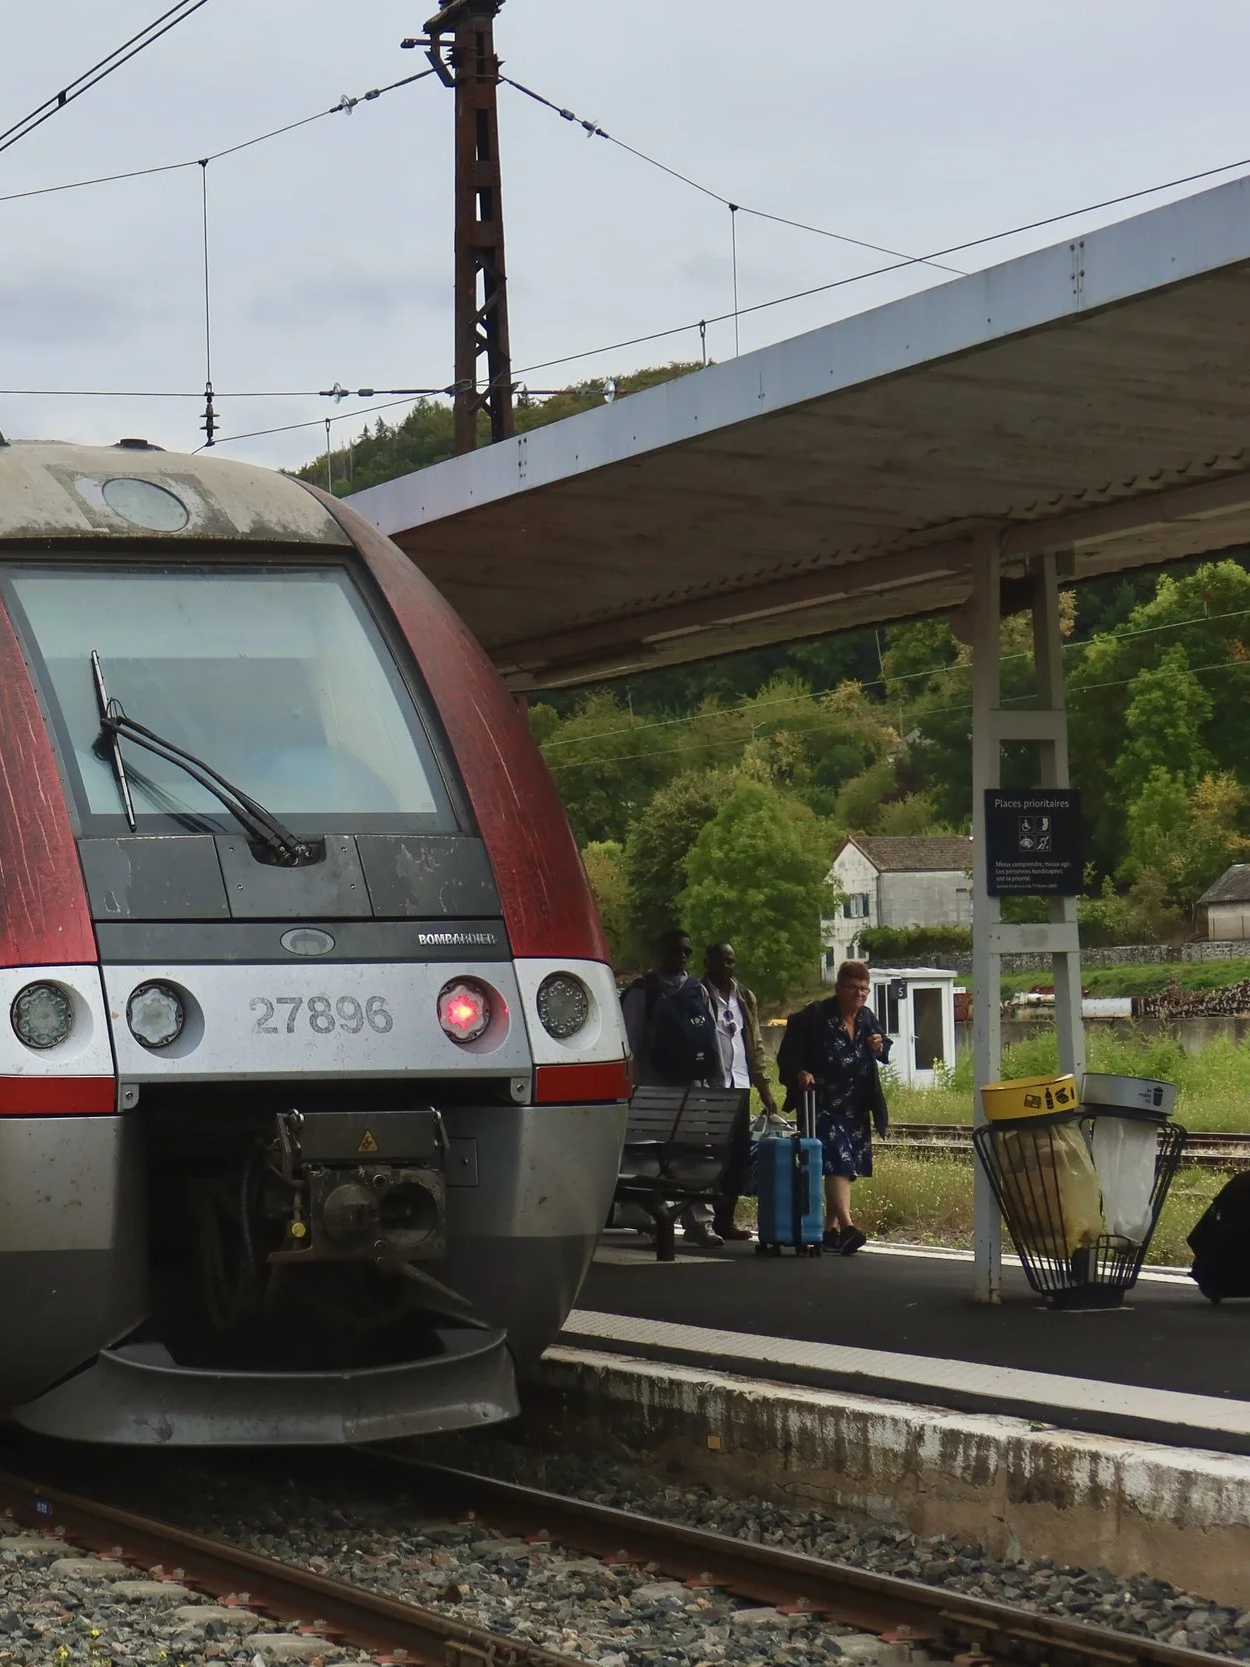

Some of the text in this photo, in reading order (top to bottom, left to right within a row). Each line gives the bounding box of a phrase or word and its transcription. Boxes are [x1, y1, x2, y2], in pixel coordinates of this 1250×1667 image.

[994, 799, 1070, 810] Places prioritaires
[418, 933, 497, 945] BOMBARDIER
[898, 987, 904, 997] 5
[249, 995, 394, 1034] 27896
